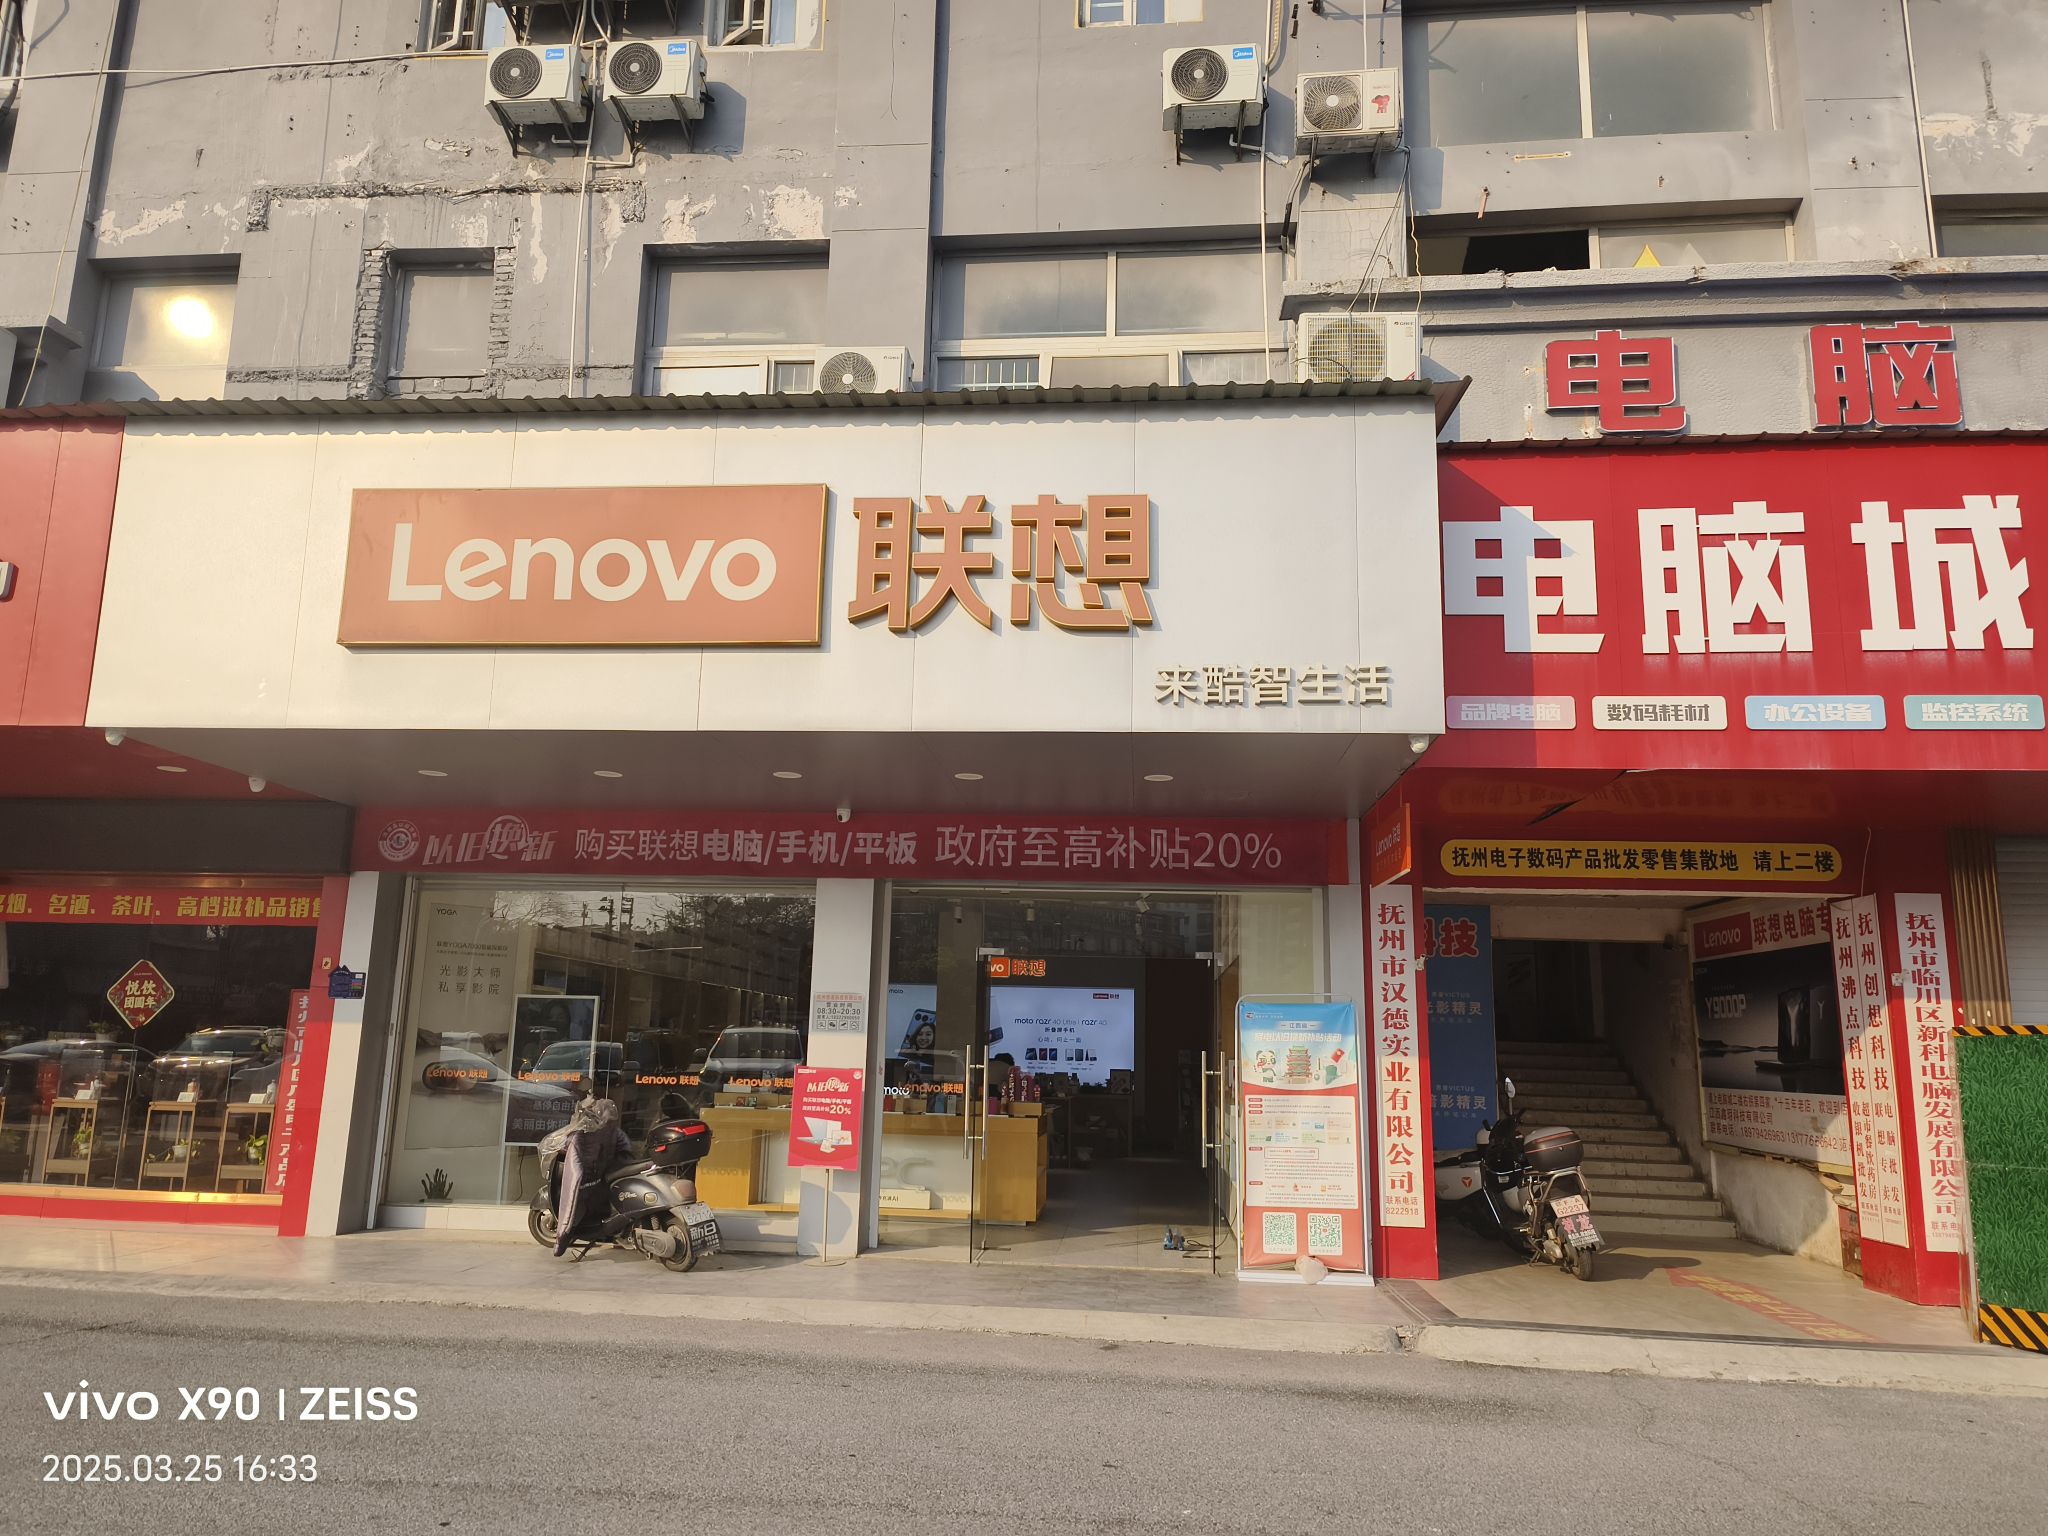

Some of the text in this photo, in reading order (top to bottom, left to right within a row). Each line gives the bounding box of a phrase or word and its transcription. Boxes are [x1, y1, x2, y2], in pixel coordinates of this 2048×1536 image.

[388, 493, 1154, 634] Lenovo 联想
[1443, 494, 2035, 655] 电脑城
[1154, 663, 1391, 707] 来酷智生活
[1460, 703, 1562, 723] 品牌电脑
[1606, 703, 1711, 723] 数码耗材
[1763, 703, 1873, 723] 办公设备
[1920, 703, 2030, 723] 监控系统
[422, 816, 559, 866] 以旧换新
[574, 829, 917, 866] 购买联想电脑/手机/平板
[935, 825, 1282, 871] 政府至高补贴20%
[1451, 846, 1836, 874] 抚州电子数码产品批发零售集散地 请上二楼
[1703, 927, 1741, 948] Lenovo
[440, 965, 501, 979] 光影大师
[1011, 959, 1046, 977] 联想
[438, 981, 501, 995] 私享影院
[1835, 915, 1868, 1094] 抚州沸点科技
[1857, 911, 1890, 1093] 抚州创想科技
[1377, 902, 1416, 1195] 抚州市汉德实业有限公司
[426, 1067, 467, 1079] Lenovo
[1905, 912, 1960, 1217] 抚州市临川区新科电脑发展有限公司
[517, 1070, 558, 1082] Lenovo
[635, 1074, 677, 1085] Lenovo
[729, 1076, 772, 1088] Lenovo
[943, 1082, 964, 1094] 联想
[1385, 1207, 1419, 1216] 8222918
[689, 1221, 717, 1241] 新日
[1931, 1221, 1961, 1231] 联系电
